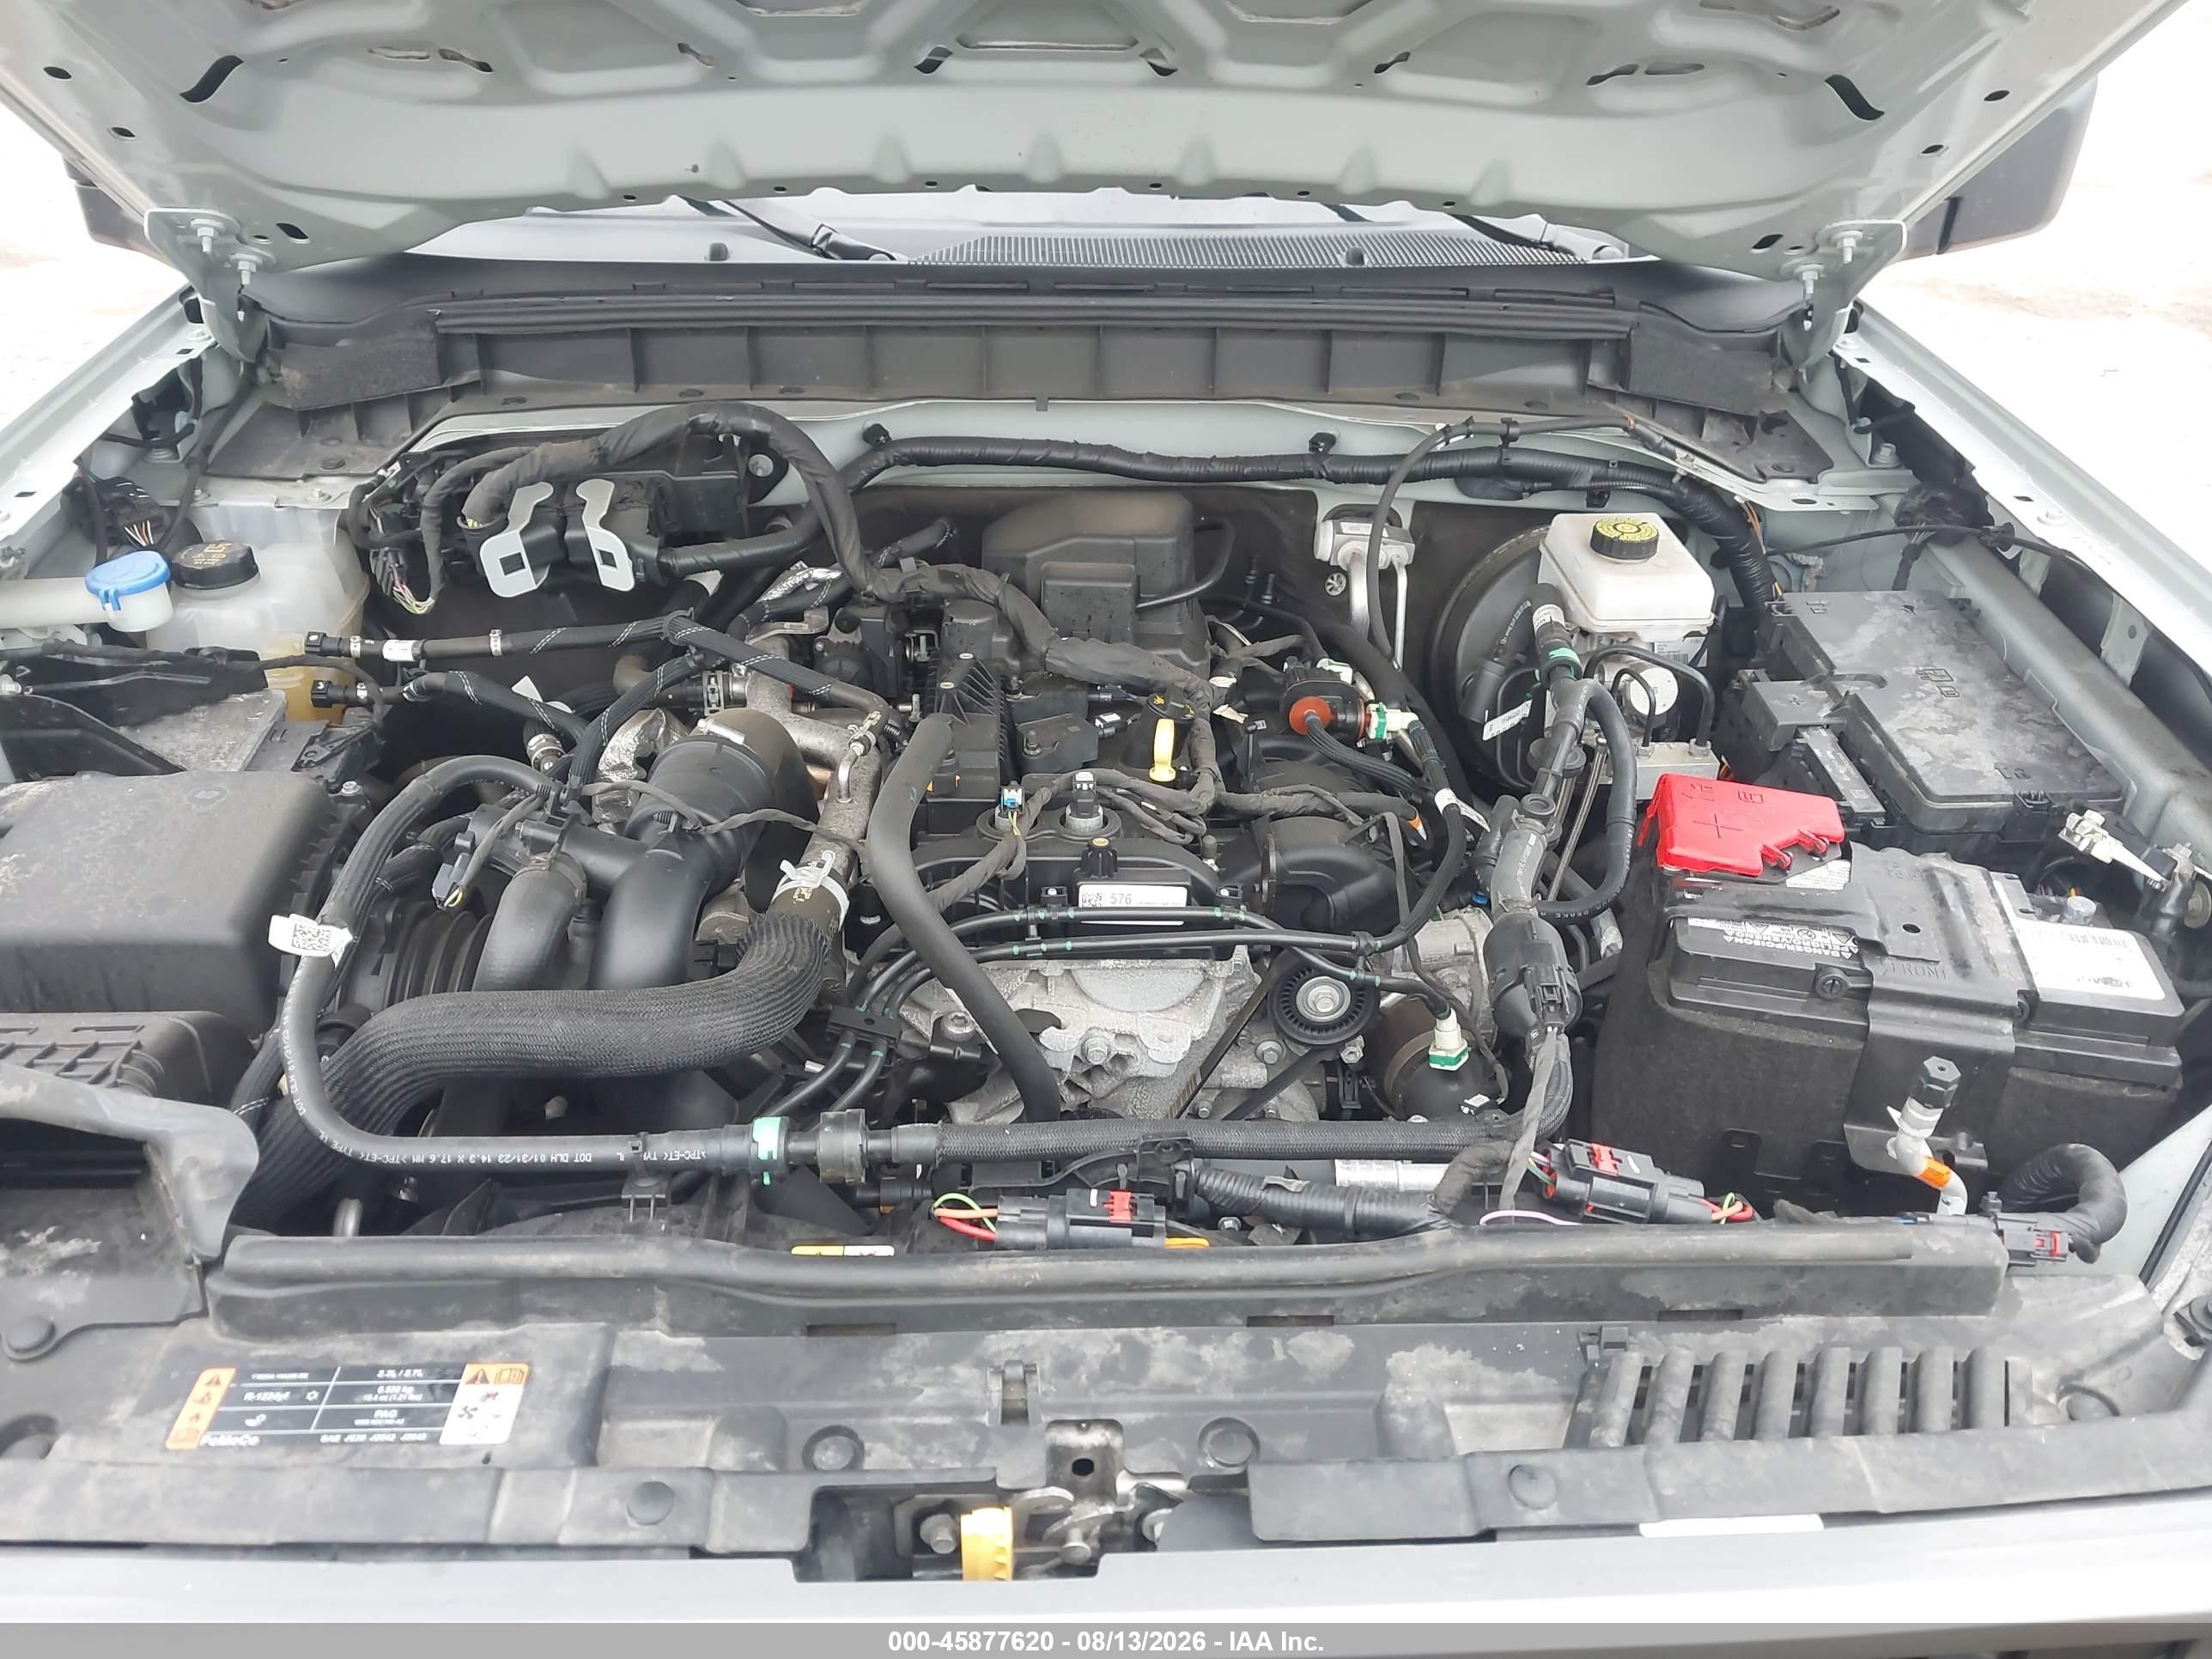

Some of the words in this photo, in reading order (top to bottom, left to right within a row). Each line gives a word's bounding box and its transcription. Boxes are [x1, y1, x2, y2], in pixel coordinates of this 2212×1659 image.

[1110, 893, 1132, 905] 576
[429, 1154, 452, 1164] 17.6
[469, 1154, 492, 1164] 14.3
[498, 1153, 545, 1164] 01/31/23
[550, 1153, 568, 1163] DLH
[574, 1153, 592, 1163] DOT
